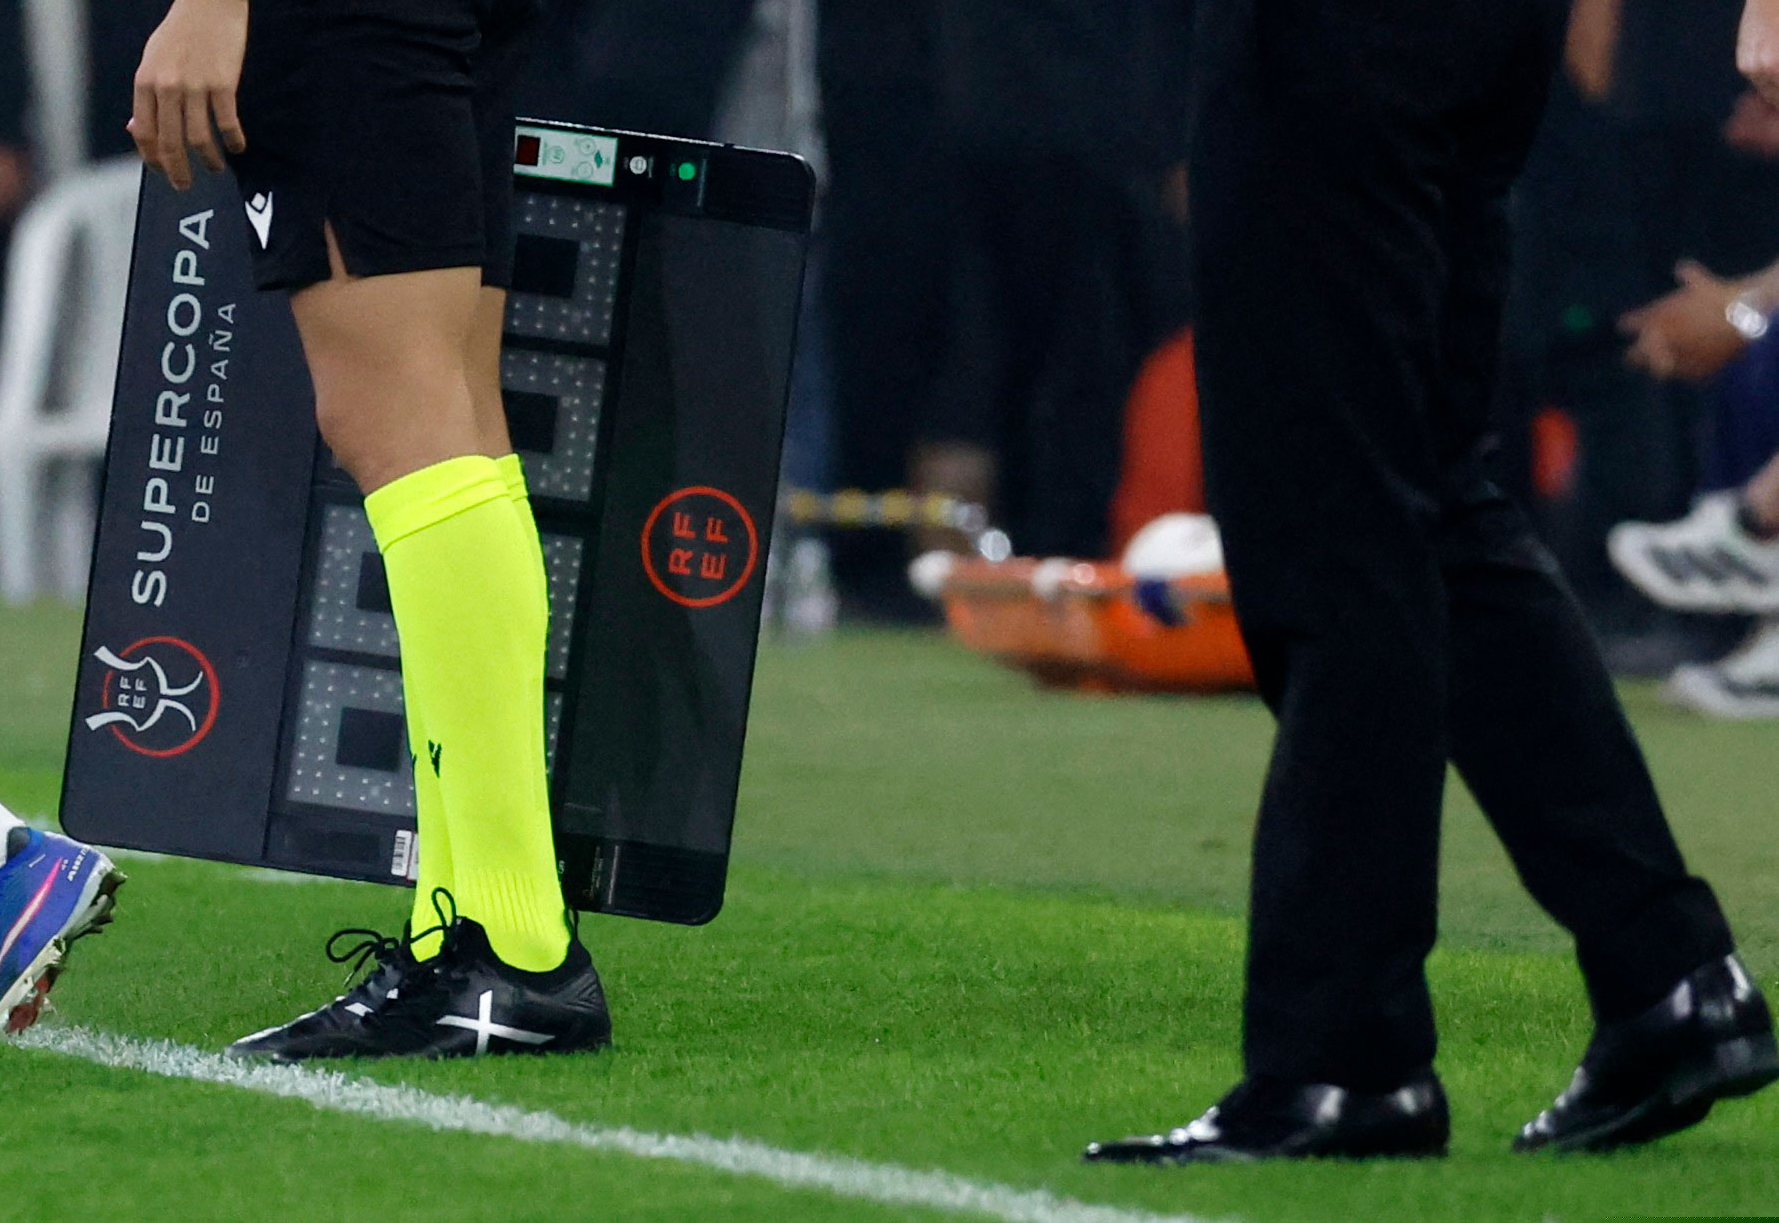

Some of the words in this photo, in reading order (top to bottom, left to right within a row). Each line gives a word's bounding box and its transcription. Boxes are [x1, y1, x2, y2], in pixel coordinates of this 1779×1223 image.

[132, 209, 214, 607] SUPERCOPA
[200, 303, 237, 455] ESPAÑA
[191, 474, 215, 523] DE
[668, 511, 696, 575] RF
[700, 517, 729, 580] EF
[118, 675, 131, 707] RF
[133, 678, 147, 709] EF
